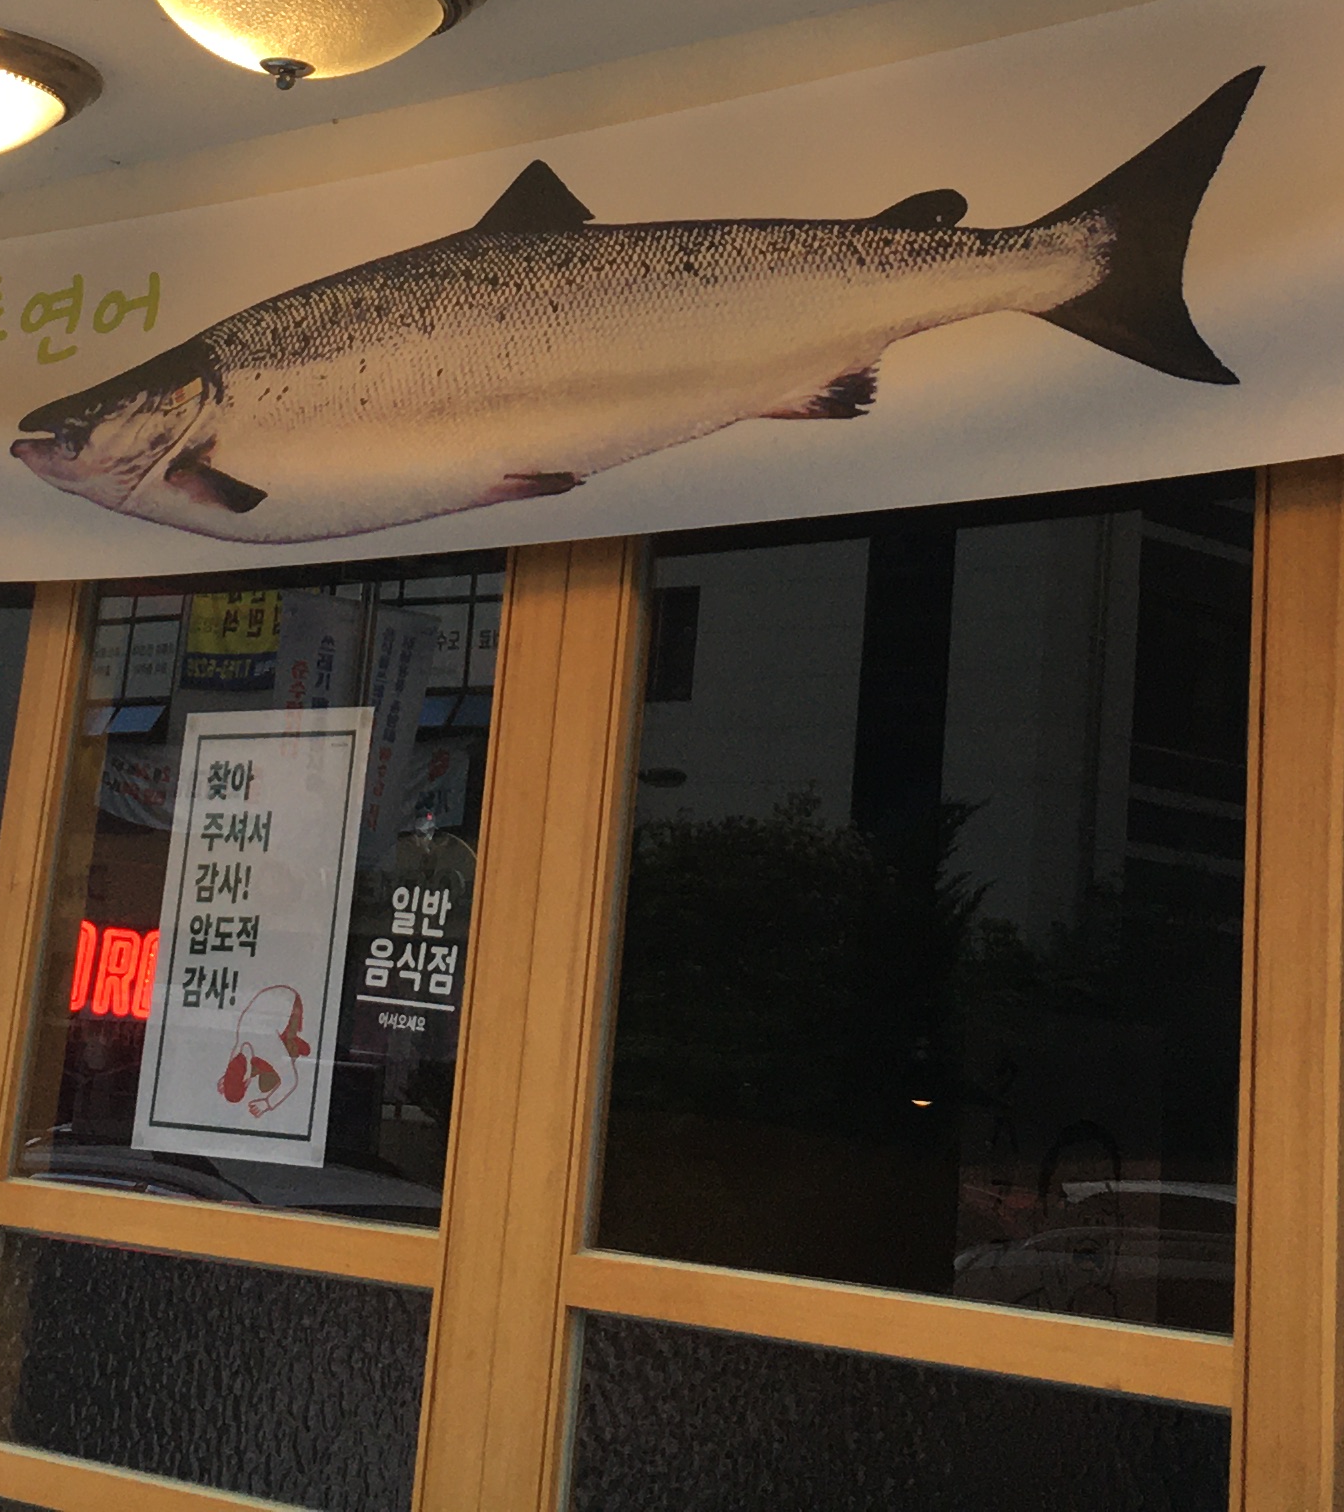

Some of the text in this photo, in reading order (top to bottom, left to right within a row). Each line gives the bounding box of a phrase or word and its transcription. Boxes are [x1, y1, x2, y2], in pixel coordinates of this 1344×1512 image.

[207, 760, 254, 800] 찾아
[201, 811, 272, 852] 주셔서
[195, 862, 252, 904] 감사!
[392, 886, 452, 938] 일반
[189, 913, 260, 957] 압도적
[182, 966, 239, 1009] 감사!
[365, 938, 458, 995] 음식점
[378, 1012, 426, 1031] 어서오세요
